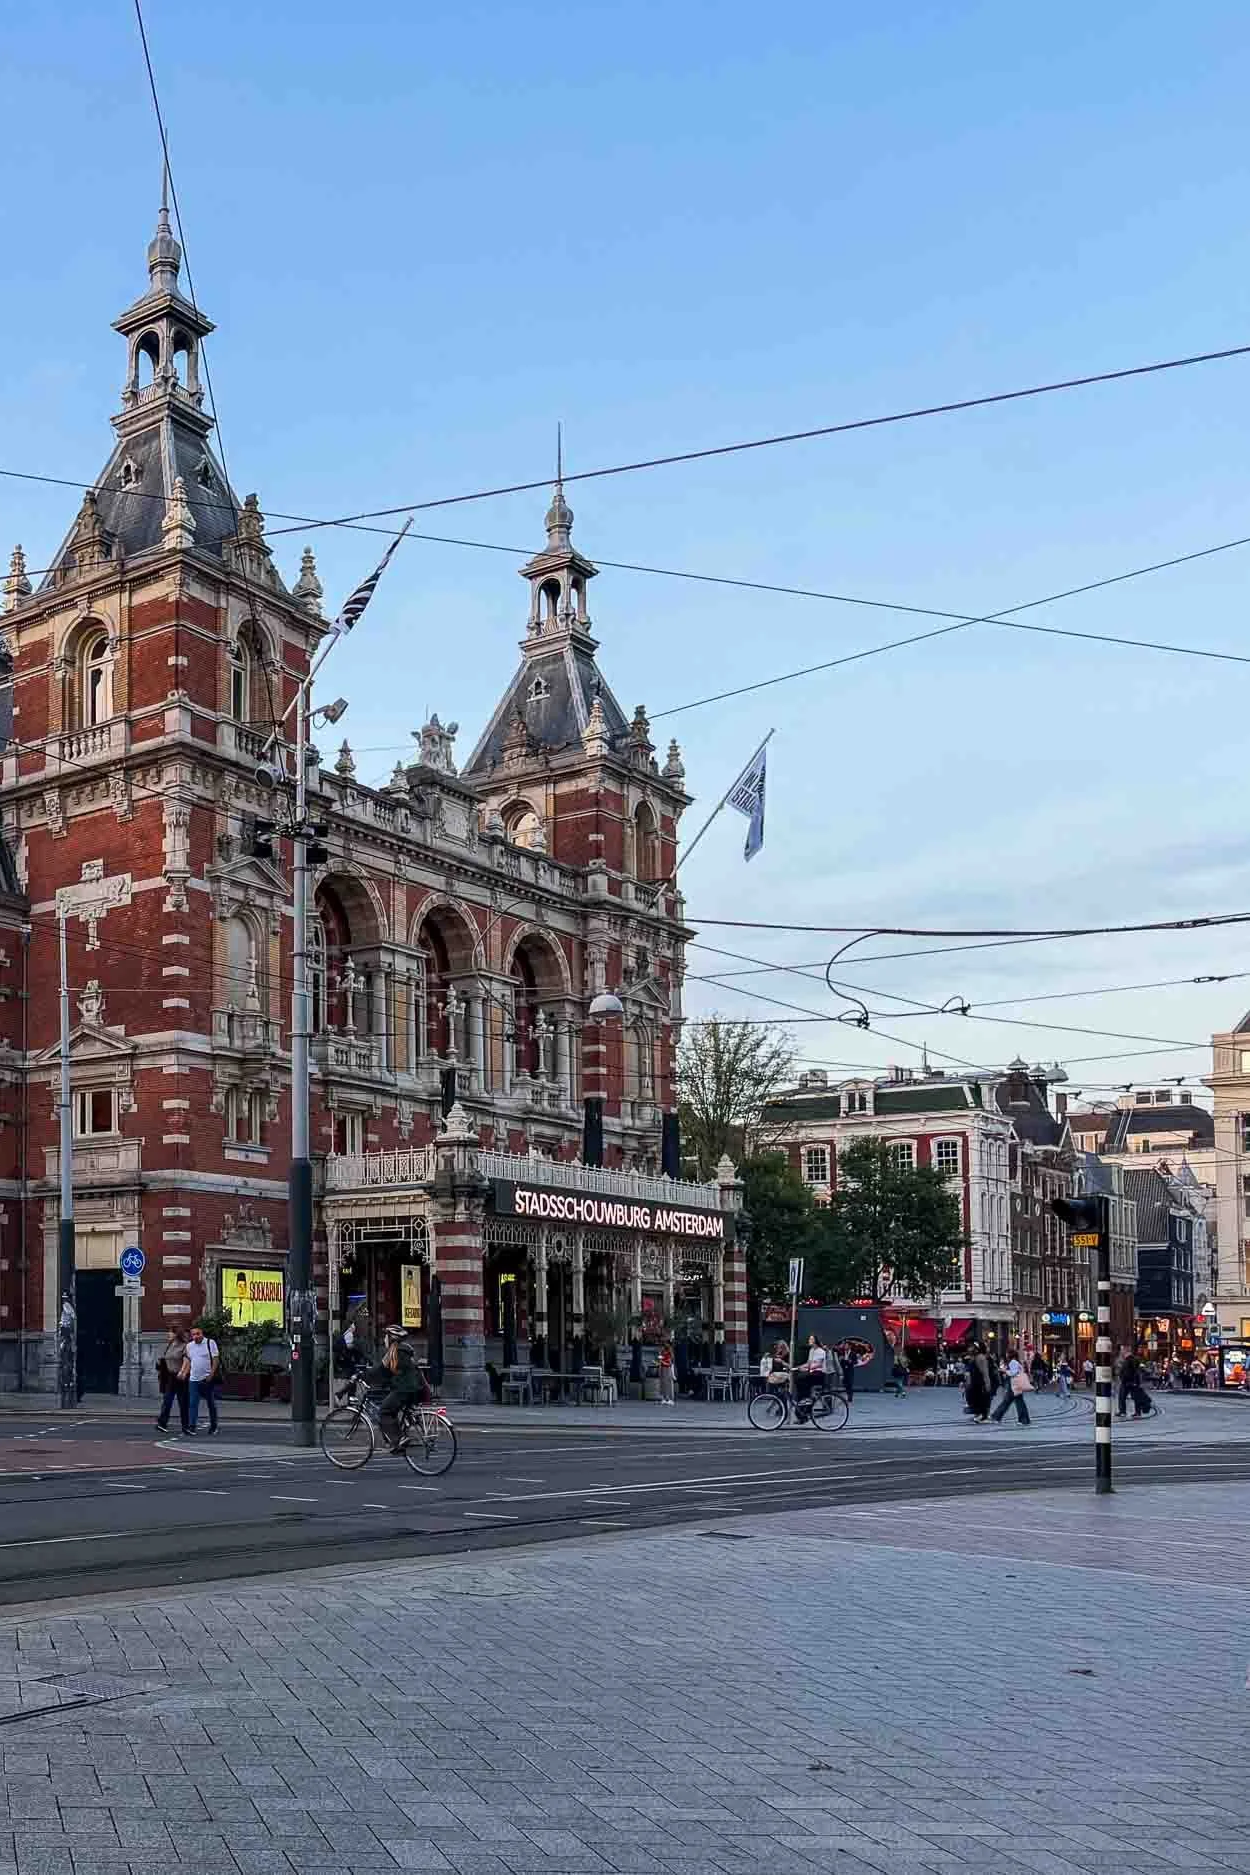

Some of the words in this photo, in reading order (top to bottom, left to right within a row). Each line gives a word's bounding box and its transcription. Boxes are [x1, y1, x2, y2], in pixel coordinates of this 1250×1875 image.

[515, 1190, 651, 1229] STADSSCHOUWBURG
[654, 1208, 725, 1238] AMSTERDAM
[249, 1280, 283, 1303] SOEKARNO
